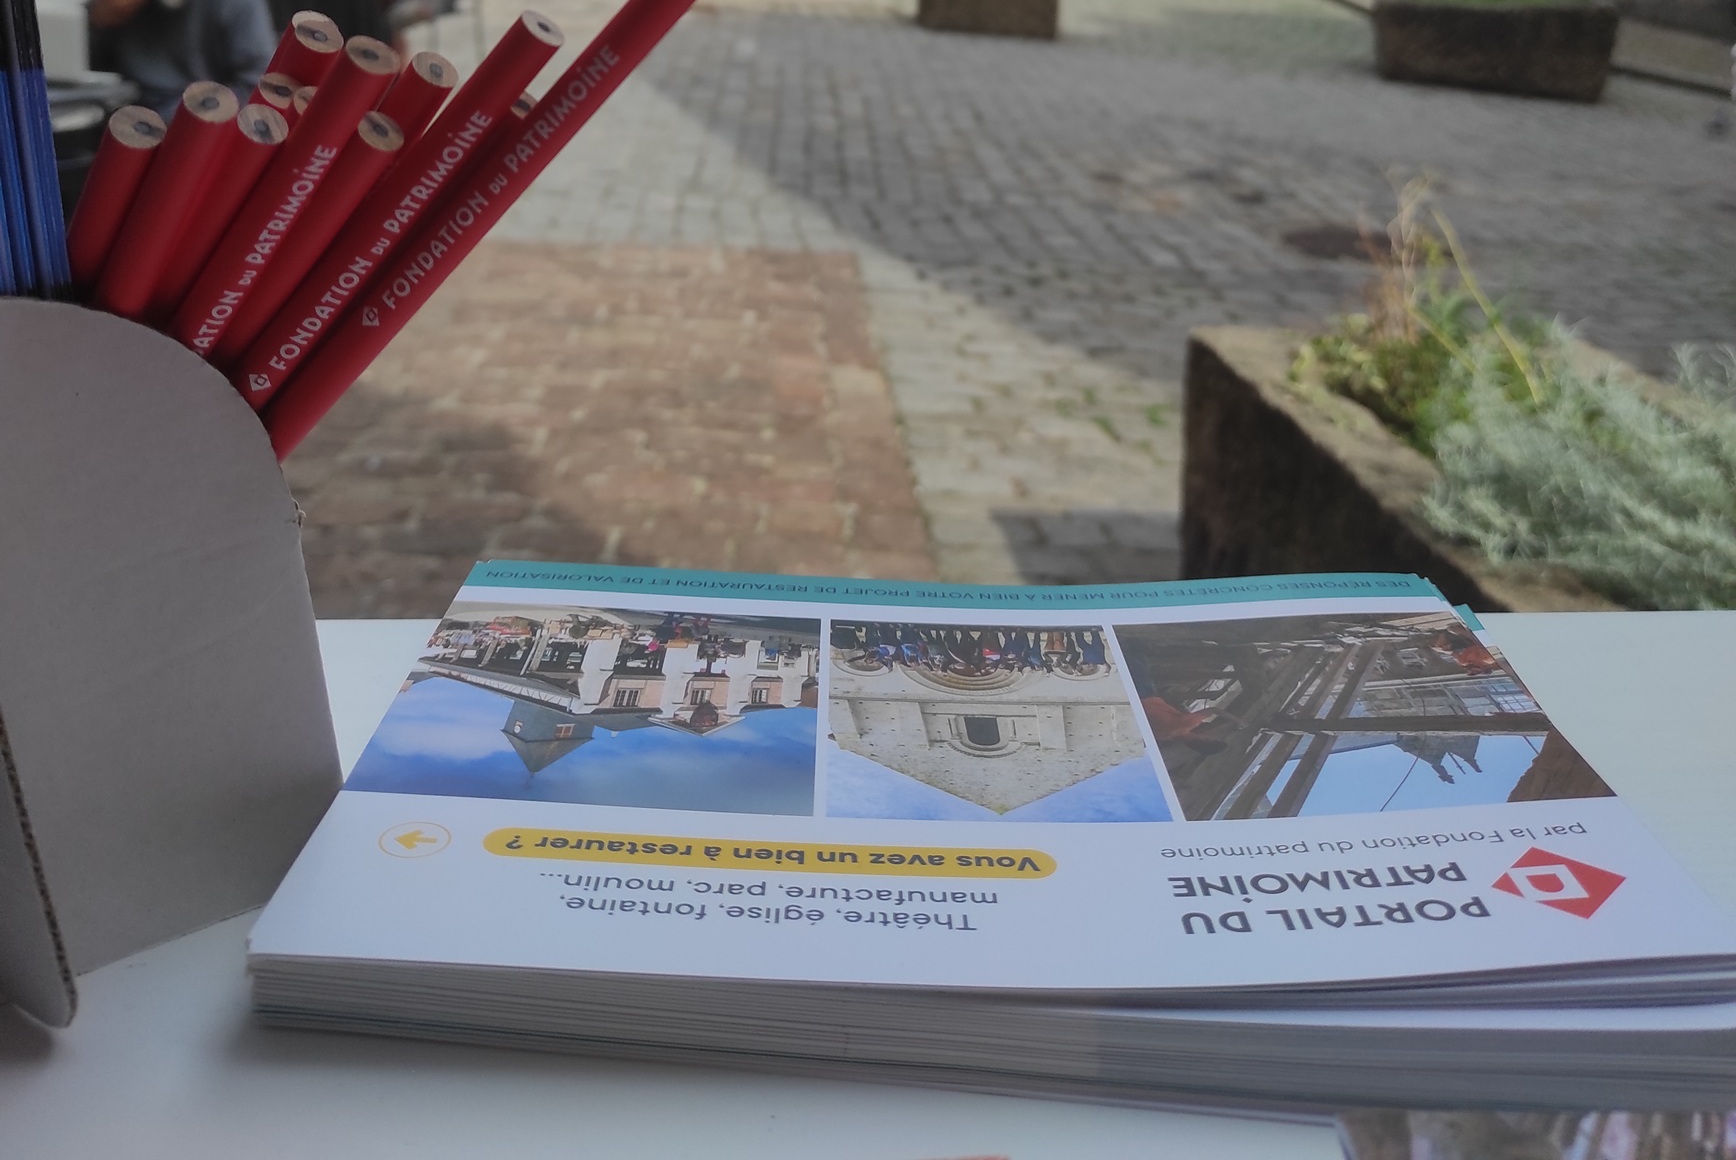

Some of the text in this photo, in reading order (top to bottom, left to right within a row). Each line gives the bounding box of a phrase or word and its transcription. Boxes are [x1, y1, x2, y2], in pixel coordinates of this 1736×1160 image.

[382, 45, 620, 309] FONDATION DU PATRIMOINE
[192, 144, 338, 354] ATION DU PATRIMOINE
[269, 111, 493, 371] FONDATION DU PATRIMOINE
[486, 570, 1410, 602] DES RÉPONSES CONCRÈTES POUR MENER À BIEN VOTRE PROJET DE RESTAURATION ET DE VALORISATION
[505, 835, 1041, 871] Vous avez un bien à restaurer ?
[1160, 821, 1588, 861] par la Fondation du patrimoine
[539, 873, 998, 905] manufacture, parc, moulin...
[1167, 861, 1467, 905] PATRIMOINE
[559, 894, 978, 931] Théâtre, église, fontaine,
[1181, 895, 1492, 935] PORTAIL DU
